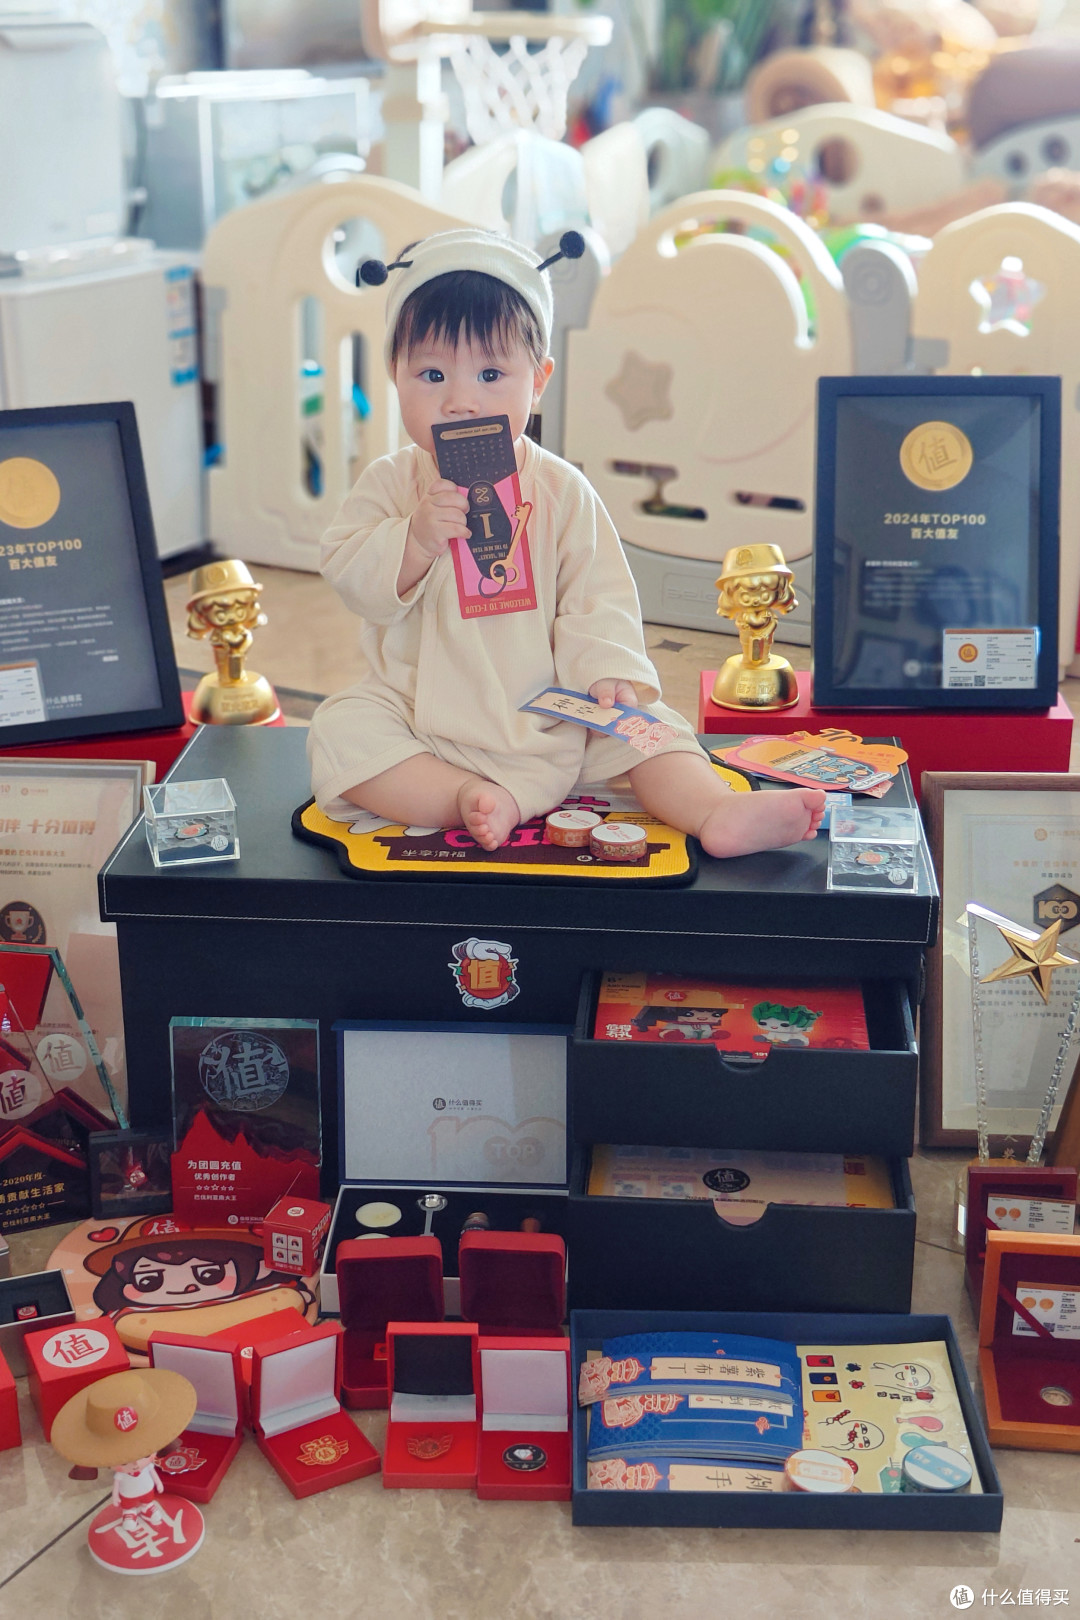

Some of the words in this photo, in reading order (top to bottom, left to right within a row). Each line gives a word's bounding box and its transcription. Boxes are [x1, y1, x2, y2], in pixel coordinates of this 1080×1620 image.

[918, 437, 957, 475] 值
[884, 513, 987, 526] 2024年TOP100
[911, 528, 959, 540] 百大值友
[9, 555, 58, 571] 百大值友
[489, 602, 498, 611] TO
[500, 597, 532, 610] WELCOME
[27, 818, 96, 836] 十分值得
[468, 958, 502, 991] 值
[43, 1040, 82, 1073] 值
[187, 1160, 242, 1171] 为团圆充值
[194, 1172, 236, 1181] 优秀创作者
[53, 1334, 105, 1364] 值
[668, 1362, 767, 1382] 紫薯布丁
[117, 1411, 137, 1430] 值
